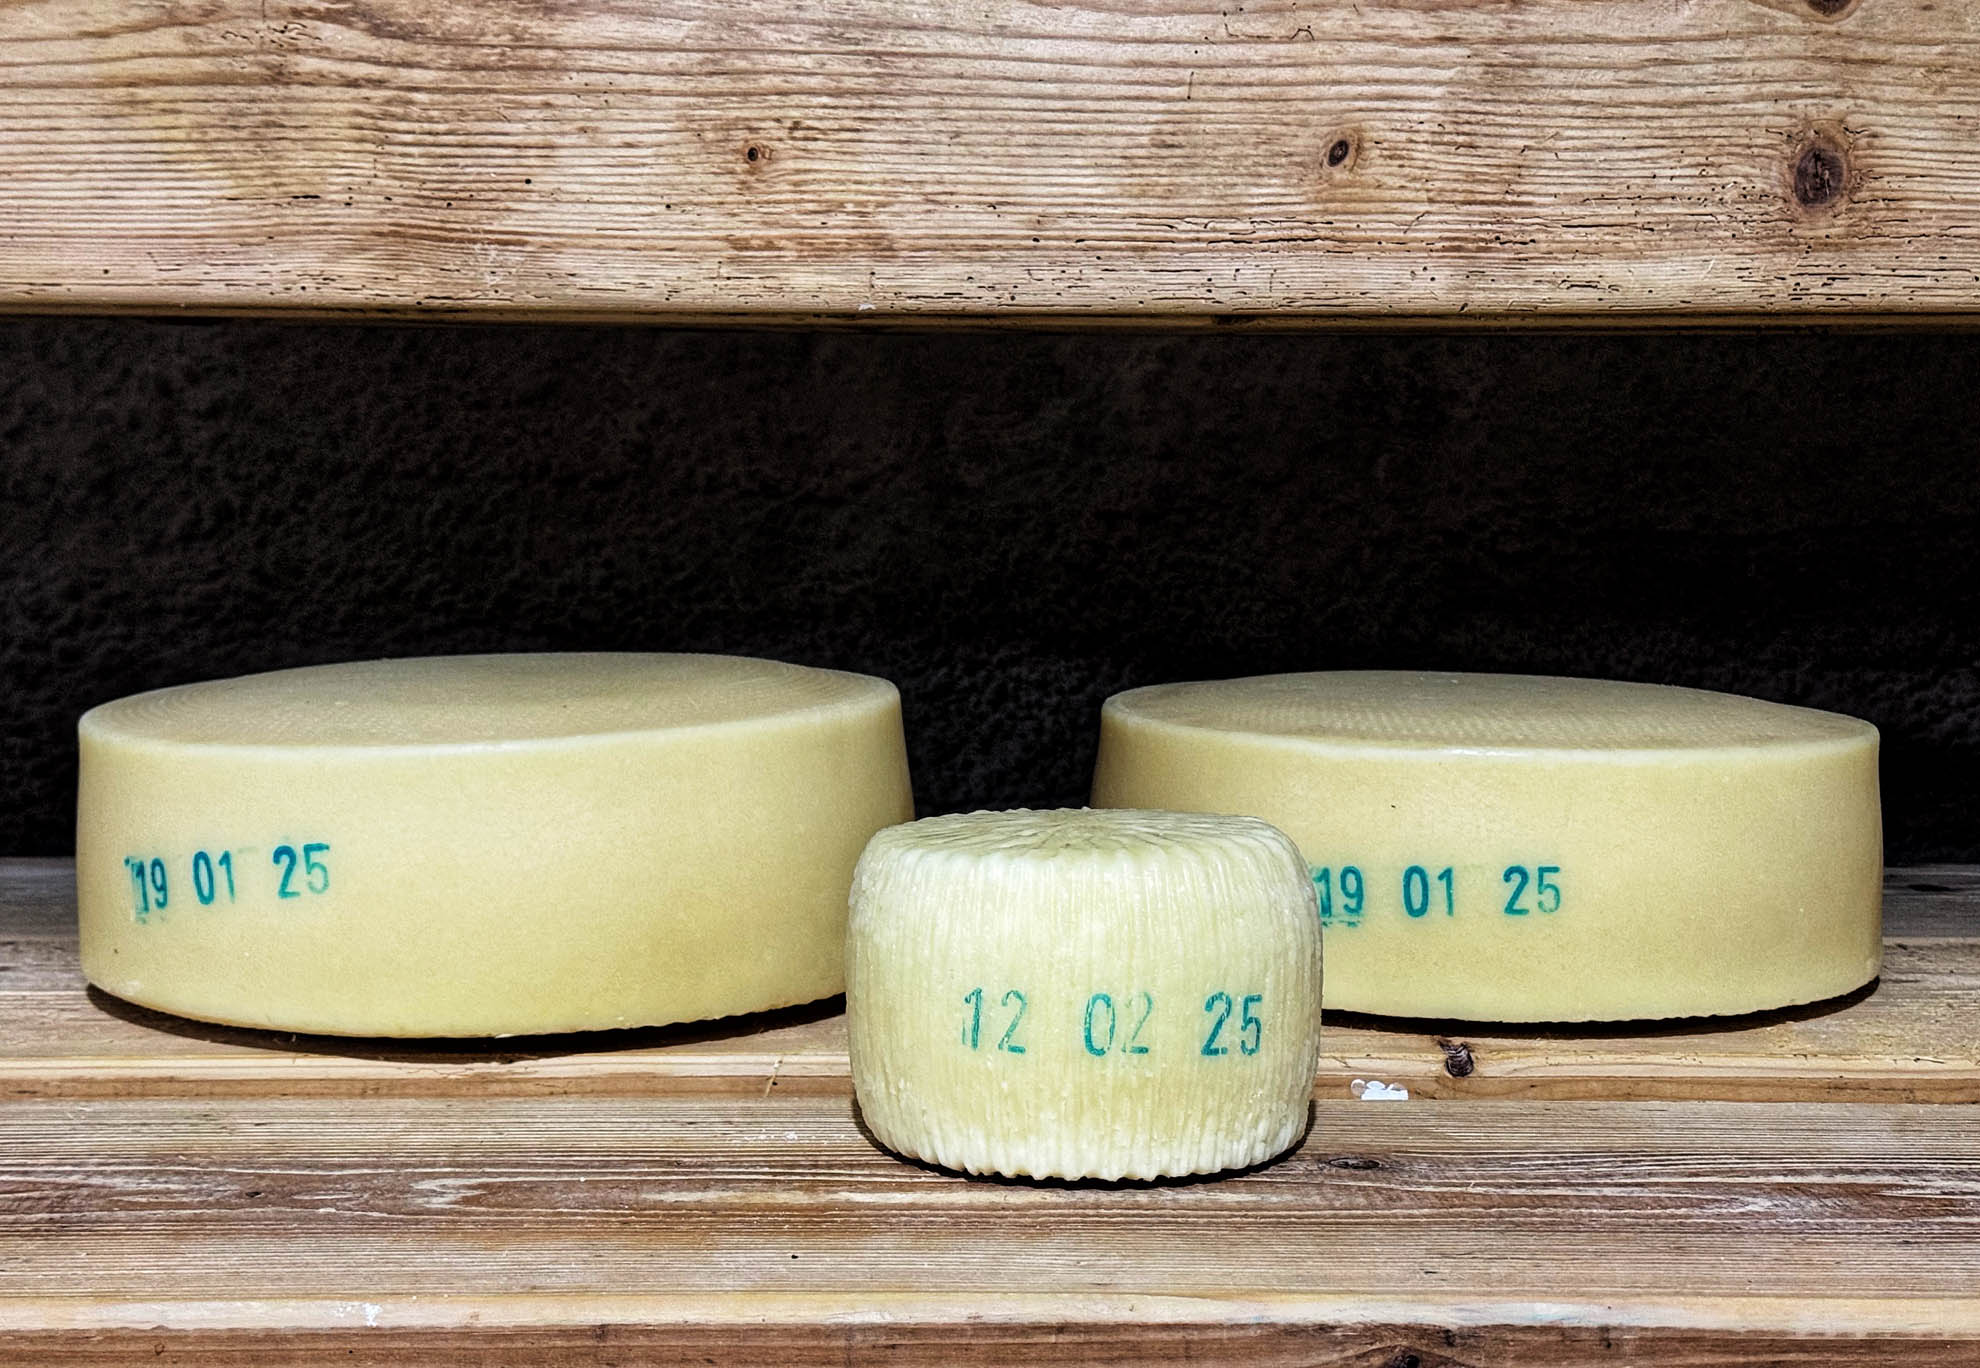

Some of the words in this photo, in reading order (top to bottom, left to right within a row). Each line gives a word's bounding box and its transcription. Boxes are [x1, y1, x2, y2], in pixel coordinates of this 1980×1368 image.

[131, 857, 168, 914] 19
[192, 850, 235, 905] 01
[272, 843, 330, 899] 25
[1312, 865, 1364, 918] 19
[1402, 865, 1454, 918] 01
[1502, 864, 1561, 916] 25
[963, 987, 1027, 1054] 12
[1083, 991, 1152, 1056] 02
[1200, 991, 1263, 1056] 25
